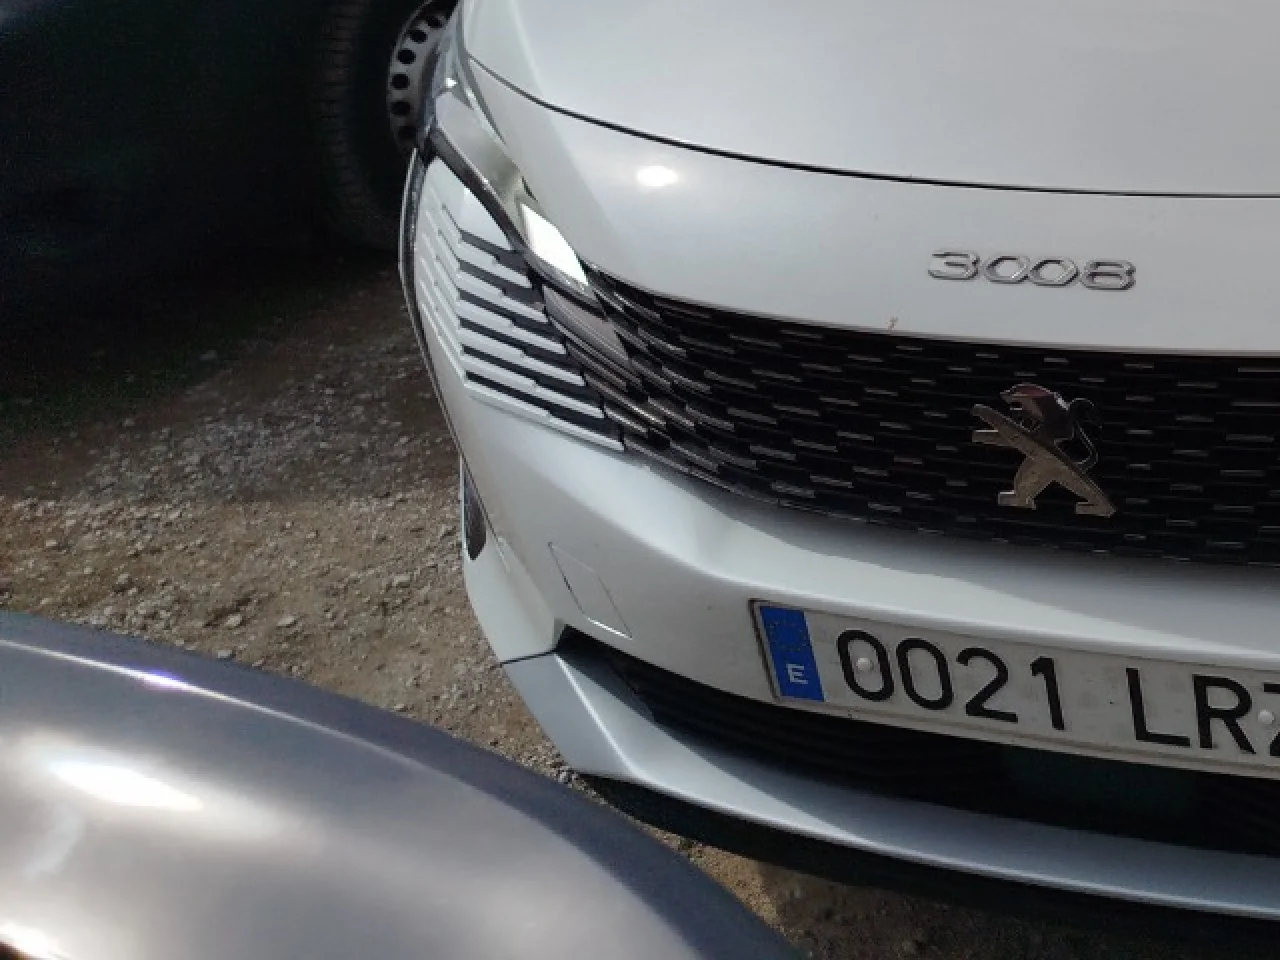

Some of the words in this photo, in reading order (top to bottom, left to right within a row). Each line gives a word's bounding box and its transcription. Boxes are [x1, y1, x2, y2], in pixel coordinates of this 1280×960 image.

[927, 249, 1137, 291] 3008
[786, 663, 808, 684] E
[837, 629, 1065, 730] 0021
